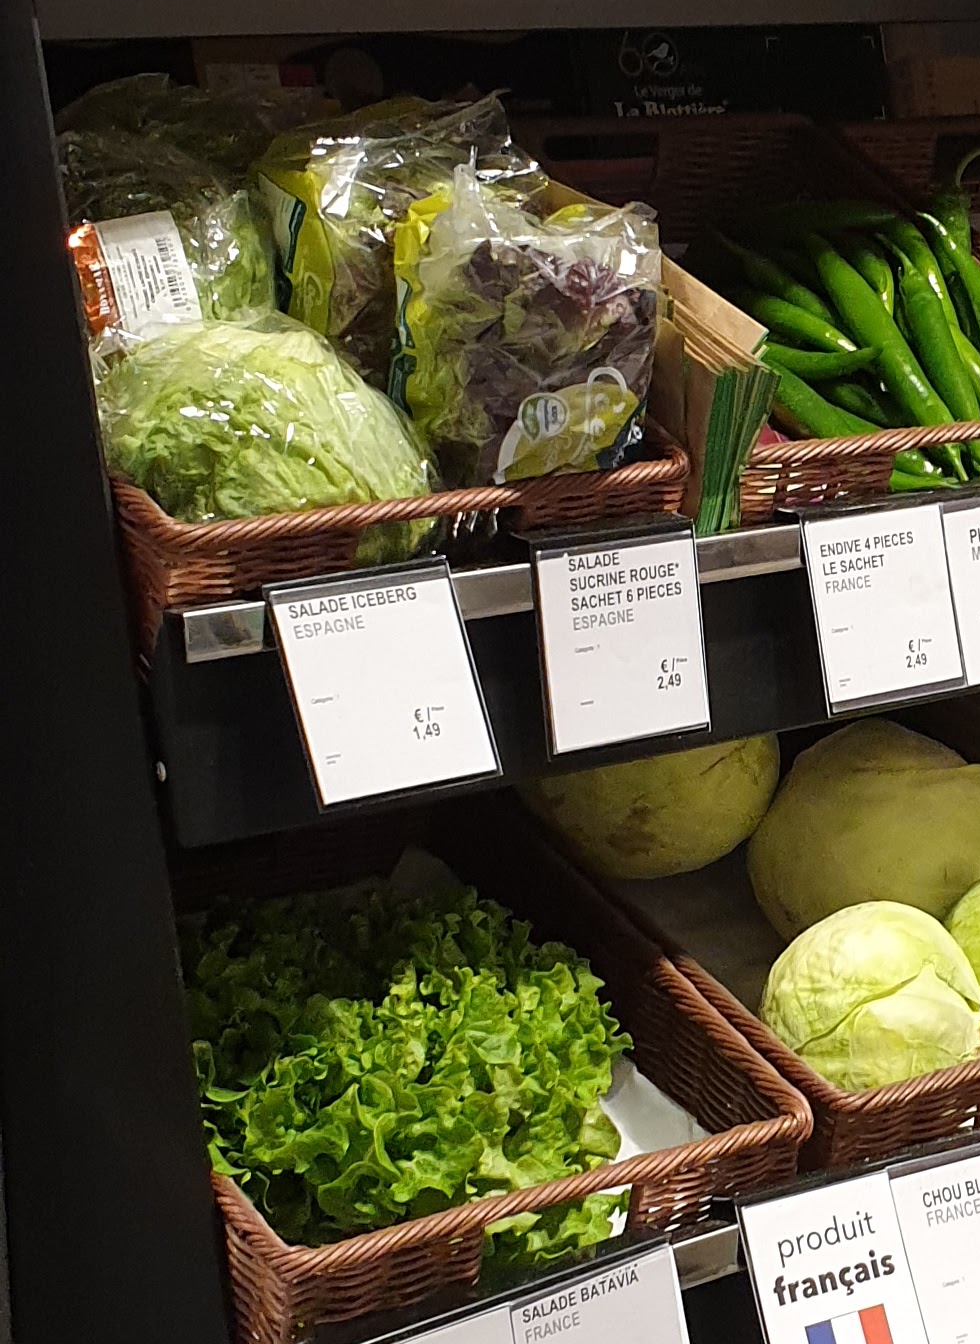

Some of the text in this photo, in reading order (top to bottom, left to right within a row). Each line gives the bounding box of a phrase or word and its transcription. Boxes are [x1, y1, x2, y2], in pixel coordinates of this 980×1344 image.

[820, 531, 914, 557] ENDIVE 4 PIECES
[568, 552, 620, 572] SALADE
[822, 554, 885, 576] LE SACHET
[569, 570, 626, 592] SUCRINE
[825, 574, 871, 594] FRANCE
[288, 586, 417, 619] SALADE ICEBERG
[571, 581, 682, 612] SACHET 6 PIECES
[293, 614, 365, 640] ESPAGNE
[573, 608, 635, 631] ESPAGNE
[905, 653, 927, 669] 2,49
[657, 673, 681, 690] 2,49
[412, 722, 441, 741] 1,49
[922, 1182, 962, 1208] CHOU
[777, 1211, 876, 1268] produit
[773, 1249, 895, 1307] français
[522, 1268, 640, 1324] SALADE BATAVIA
[524, 1311, 581, 1344] FRANCE
